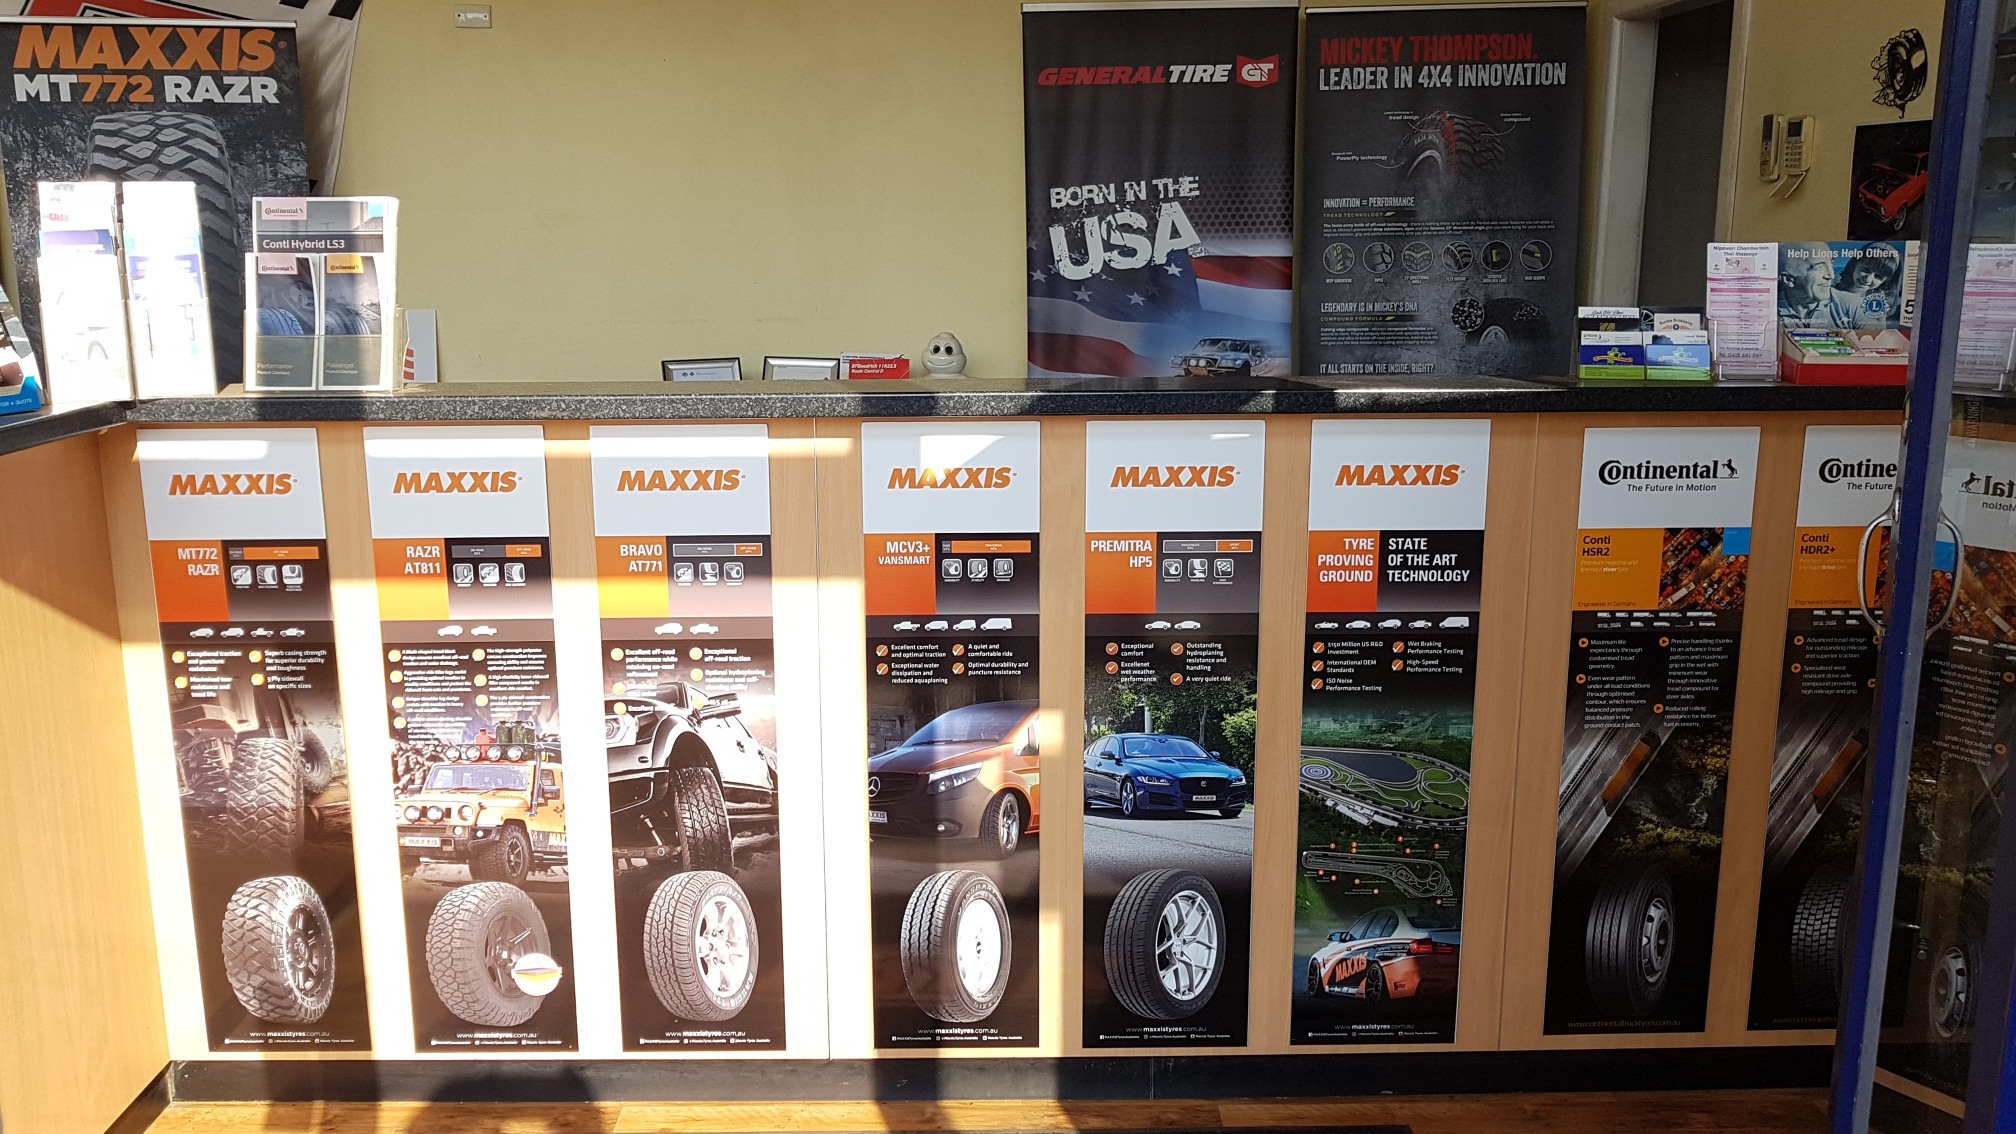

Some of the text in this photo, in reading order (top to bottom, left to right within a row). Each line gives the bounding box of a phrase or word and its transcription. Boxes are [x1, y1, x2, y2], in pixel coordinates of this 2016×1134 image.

[13, 25, 276, 71] MAXXIS
[1320, 36, 1403, 65] MICKEY
[1319, 62, 1567, 91] LEADER IN 4X4 INNOVATION
[13, 74, 280, 104] MT772 RAZR
[1050, 175, 1200, 209] BORN IN THE
[1323, 197, 1415, 209] INNOVATION PERFORMANCE
[262, 240, 345, 251] Conti Hybrid LS3
[1049, 201, 1202, 280] USA
[1788, 248, 1899, 259] Help Lions Help Others
[1321, 302, 1417, 312] LEGENDARY IS IN MICKEY'S DNA
[1872, 301, 1879, 310] L
[1320, 363, 1434, 374] IT ALL STARTS ON THE INSIDE, RIGHT?
[887, 467, 1012, 489] MAXXIS
[1110, 466, 1235, 487] MAXXIS
[1334, 464, 1460, 486] MAXXIS
[1598, 460, 1719, 485] Continental
[168, 473, 292, 495] MAXXIS
[392, 471, 517, 493] MAXXIS
[616, 469, 741, 491] MAXXIS
[1847, 482, 1893, 490] The Future
[1343, 538, 1374, 550] TYRE
[1388, 538, 1428, 550] STATE
[1583, 535, 1611, 544] Conti
[1801, 534, 1829, 542] Conti
[406, 546, 440, 558] RAZR
[620, 545, 663, 556] BRAVO
[886, 541, 931, 553] MCV3+
[1091, 540, 1152, 552] PREMITRA
[1582, 547, 1610, 556] HSR2
[1800, 545, 1835, 554] HDR2+
[178, 548, 218, 560] MT772
[1317, 554, 1374, 566] PROVING
[1388, 554, 1458, 566] OF THE ART
[628, 561, 663, 572] AT771
[878, 556, 931, 565] VANSMART
[1129, 556, 1152, 568] HP5
[188, 564, 219, 576] RAZR
[404, 562, 440, 574] AT811
[1319, 570, 1373, 582] GROUND
[1387, 570, 1470, 582] TECHNOLOGY
[1335, 952, 1368, 982] MAXXIS
